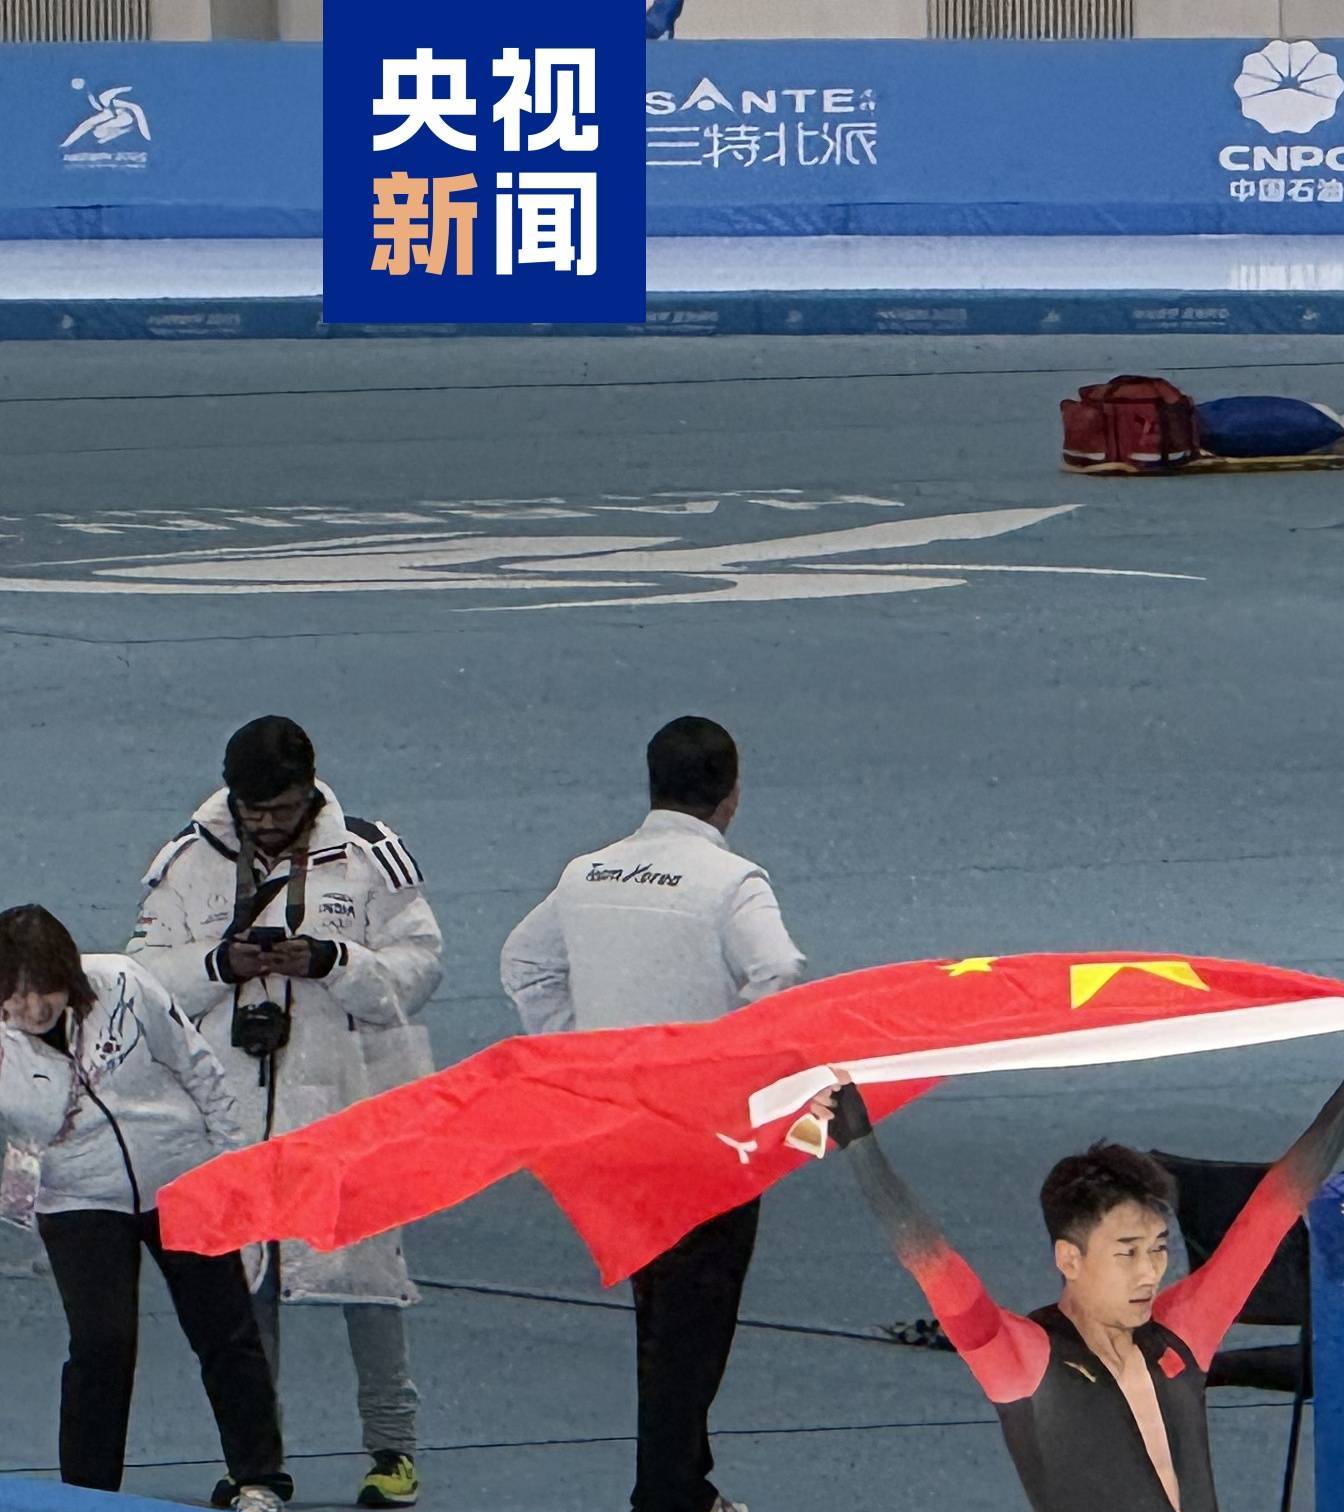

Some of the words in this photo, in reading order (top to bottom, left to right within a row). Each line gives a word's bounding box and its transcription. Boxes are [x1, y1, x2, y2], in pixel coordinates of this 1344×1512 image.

[646, 77, 855, 115] SANTE
[646, 122, 878, 168] 三特北派
[1230, 178, 1344, 202] 中国石油
